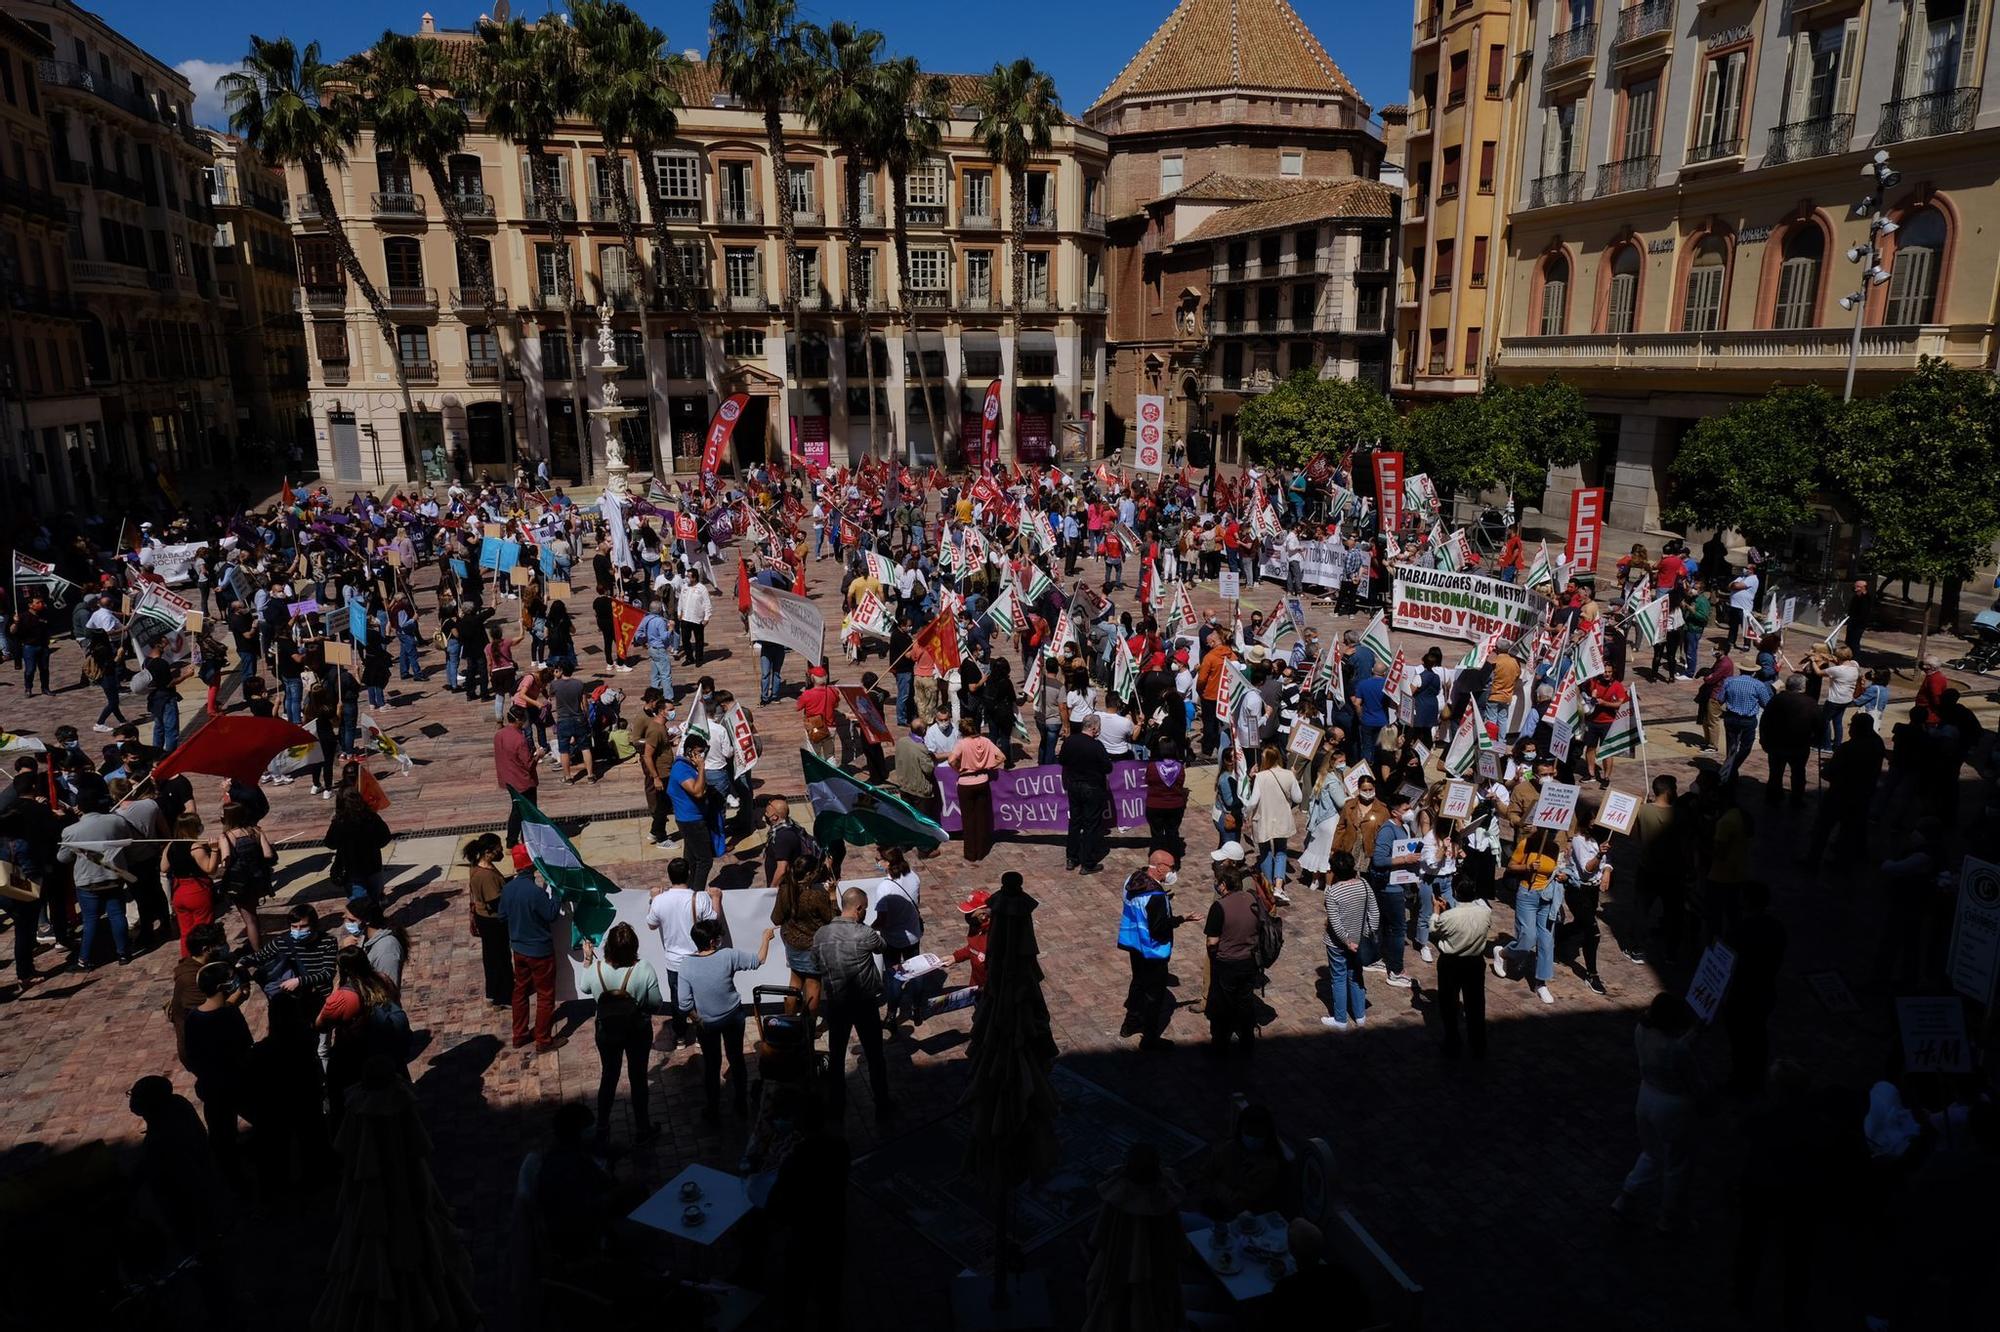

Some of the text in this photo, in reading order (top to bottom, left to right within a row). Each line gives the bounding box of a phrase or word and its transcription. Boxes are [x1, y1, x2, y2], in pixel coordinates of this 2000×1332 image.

[1378, 458, 1396, 531] CCOO
[1574, 491, 1597, 572] CCOO
[153, 586, 193, 610] CCOO
[1395, 567, 1472, 591] TRABAJADORES
[1474, 580, 1491, 596] del
[1495, 584, 1526, 604] METRO
[1398, 601, 1452, 624] ABUSO
[1456, 611, 1467, 626] Y
[1405, 586, 1499, 617] METROMÁLAGA
[1505, 604, 1513, 619] Y
[1015, 774, 1068, 796] LDAD
[1001, 803, 1058, 828] ATRÁS
[1122, 797, 1143, 818] UN
